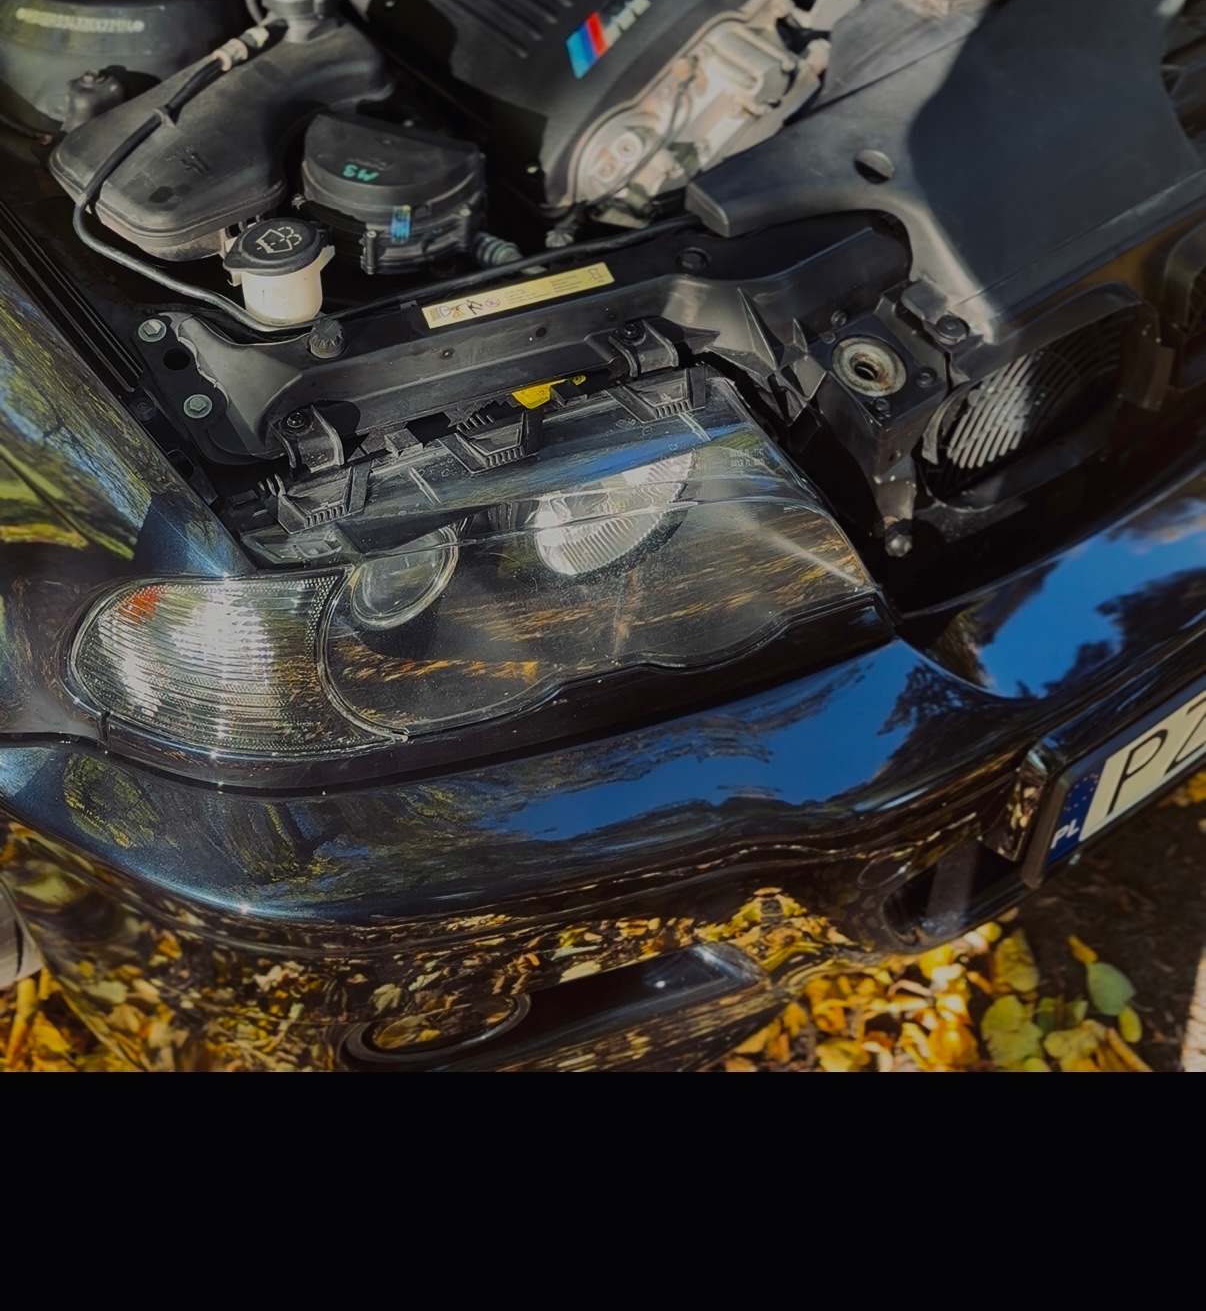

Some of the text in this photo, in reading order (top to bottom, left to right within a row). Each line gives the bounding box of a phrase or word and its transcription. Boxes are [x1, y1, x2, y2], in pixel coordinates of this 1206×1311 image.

[342, 164, 380, 181] M3
[1107, 696, 1206, 815] PZ
[1050, 819, 1079, 849] PL
